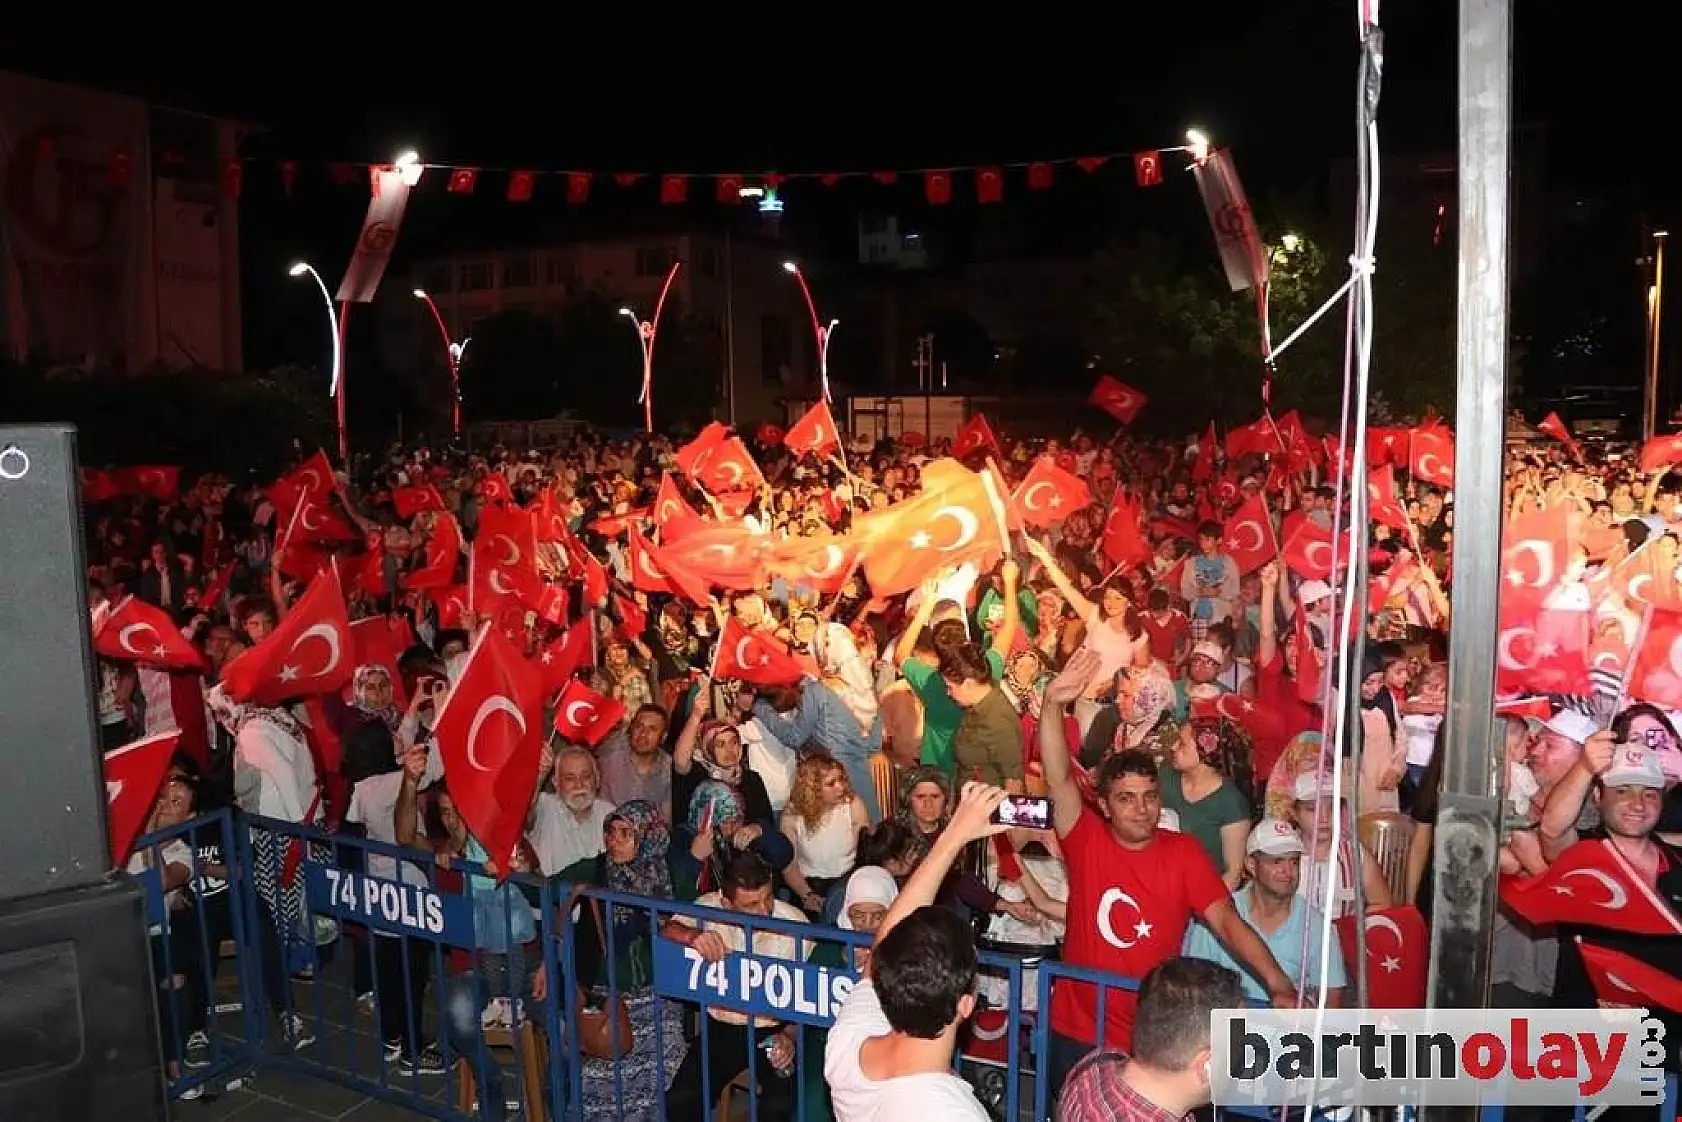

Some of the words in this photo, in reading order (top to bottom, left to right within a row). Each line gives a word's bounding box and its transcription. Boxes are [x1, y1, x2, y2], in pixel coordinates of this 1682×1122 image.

[326, 869, 357, 910] 74
[363, 878, 445, 933] POLİS
[684, 947, 729, 996] 74
